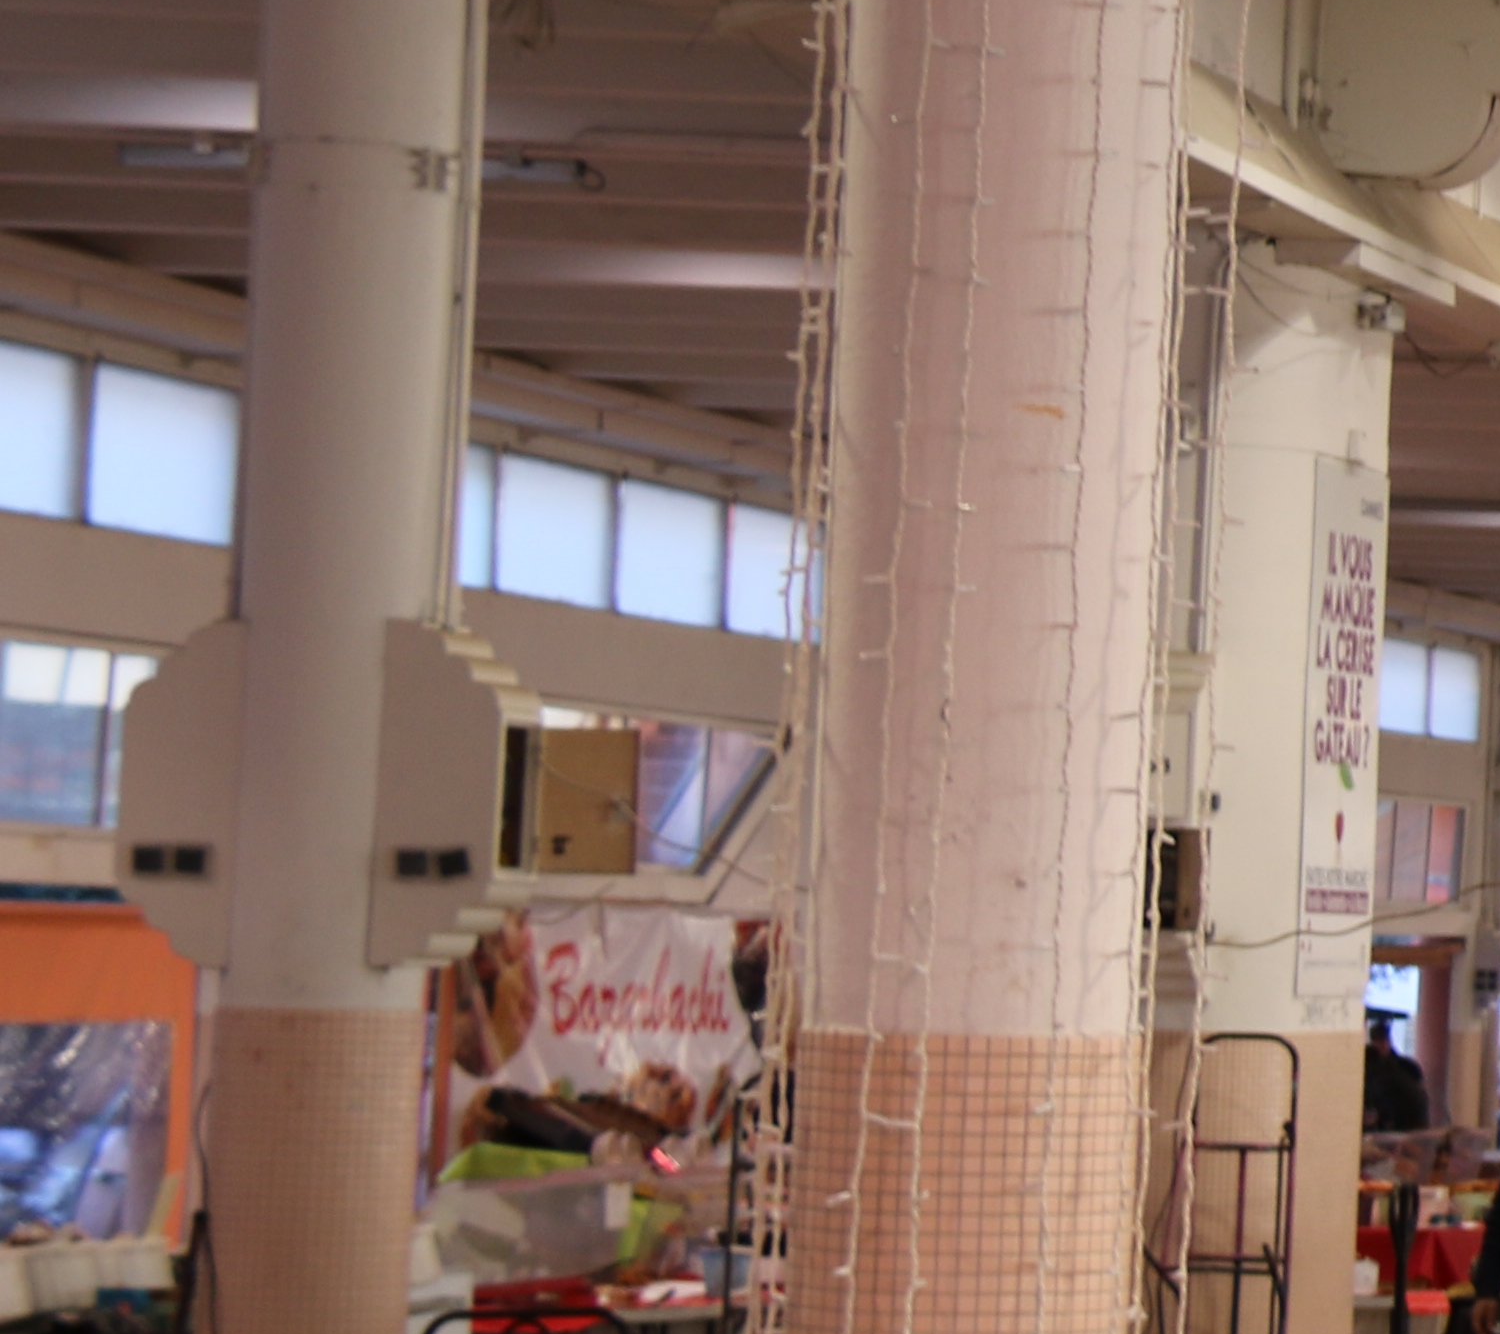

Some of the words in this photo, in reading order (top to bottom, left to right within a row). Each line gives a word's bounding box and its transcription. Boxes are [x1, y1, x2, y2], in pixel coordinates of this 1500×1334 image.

[1341, 533, 1373, 581] VOUS
[1321, 581, 1376, 630] MANQUE
[1317, 624, 1333, 668] LA
[1336, 628, 1375, 677] CERISE
[1326, 673, 1347, 717] SUR
[1350, 678, 1362, 720] LE
